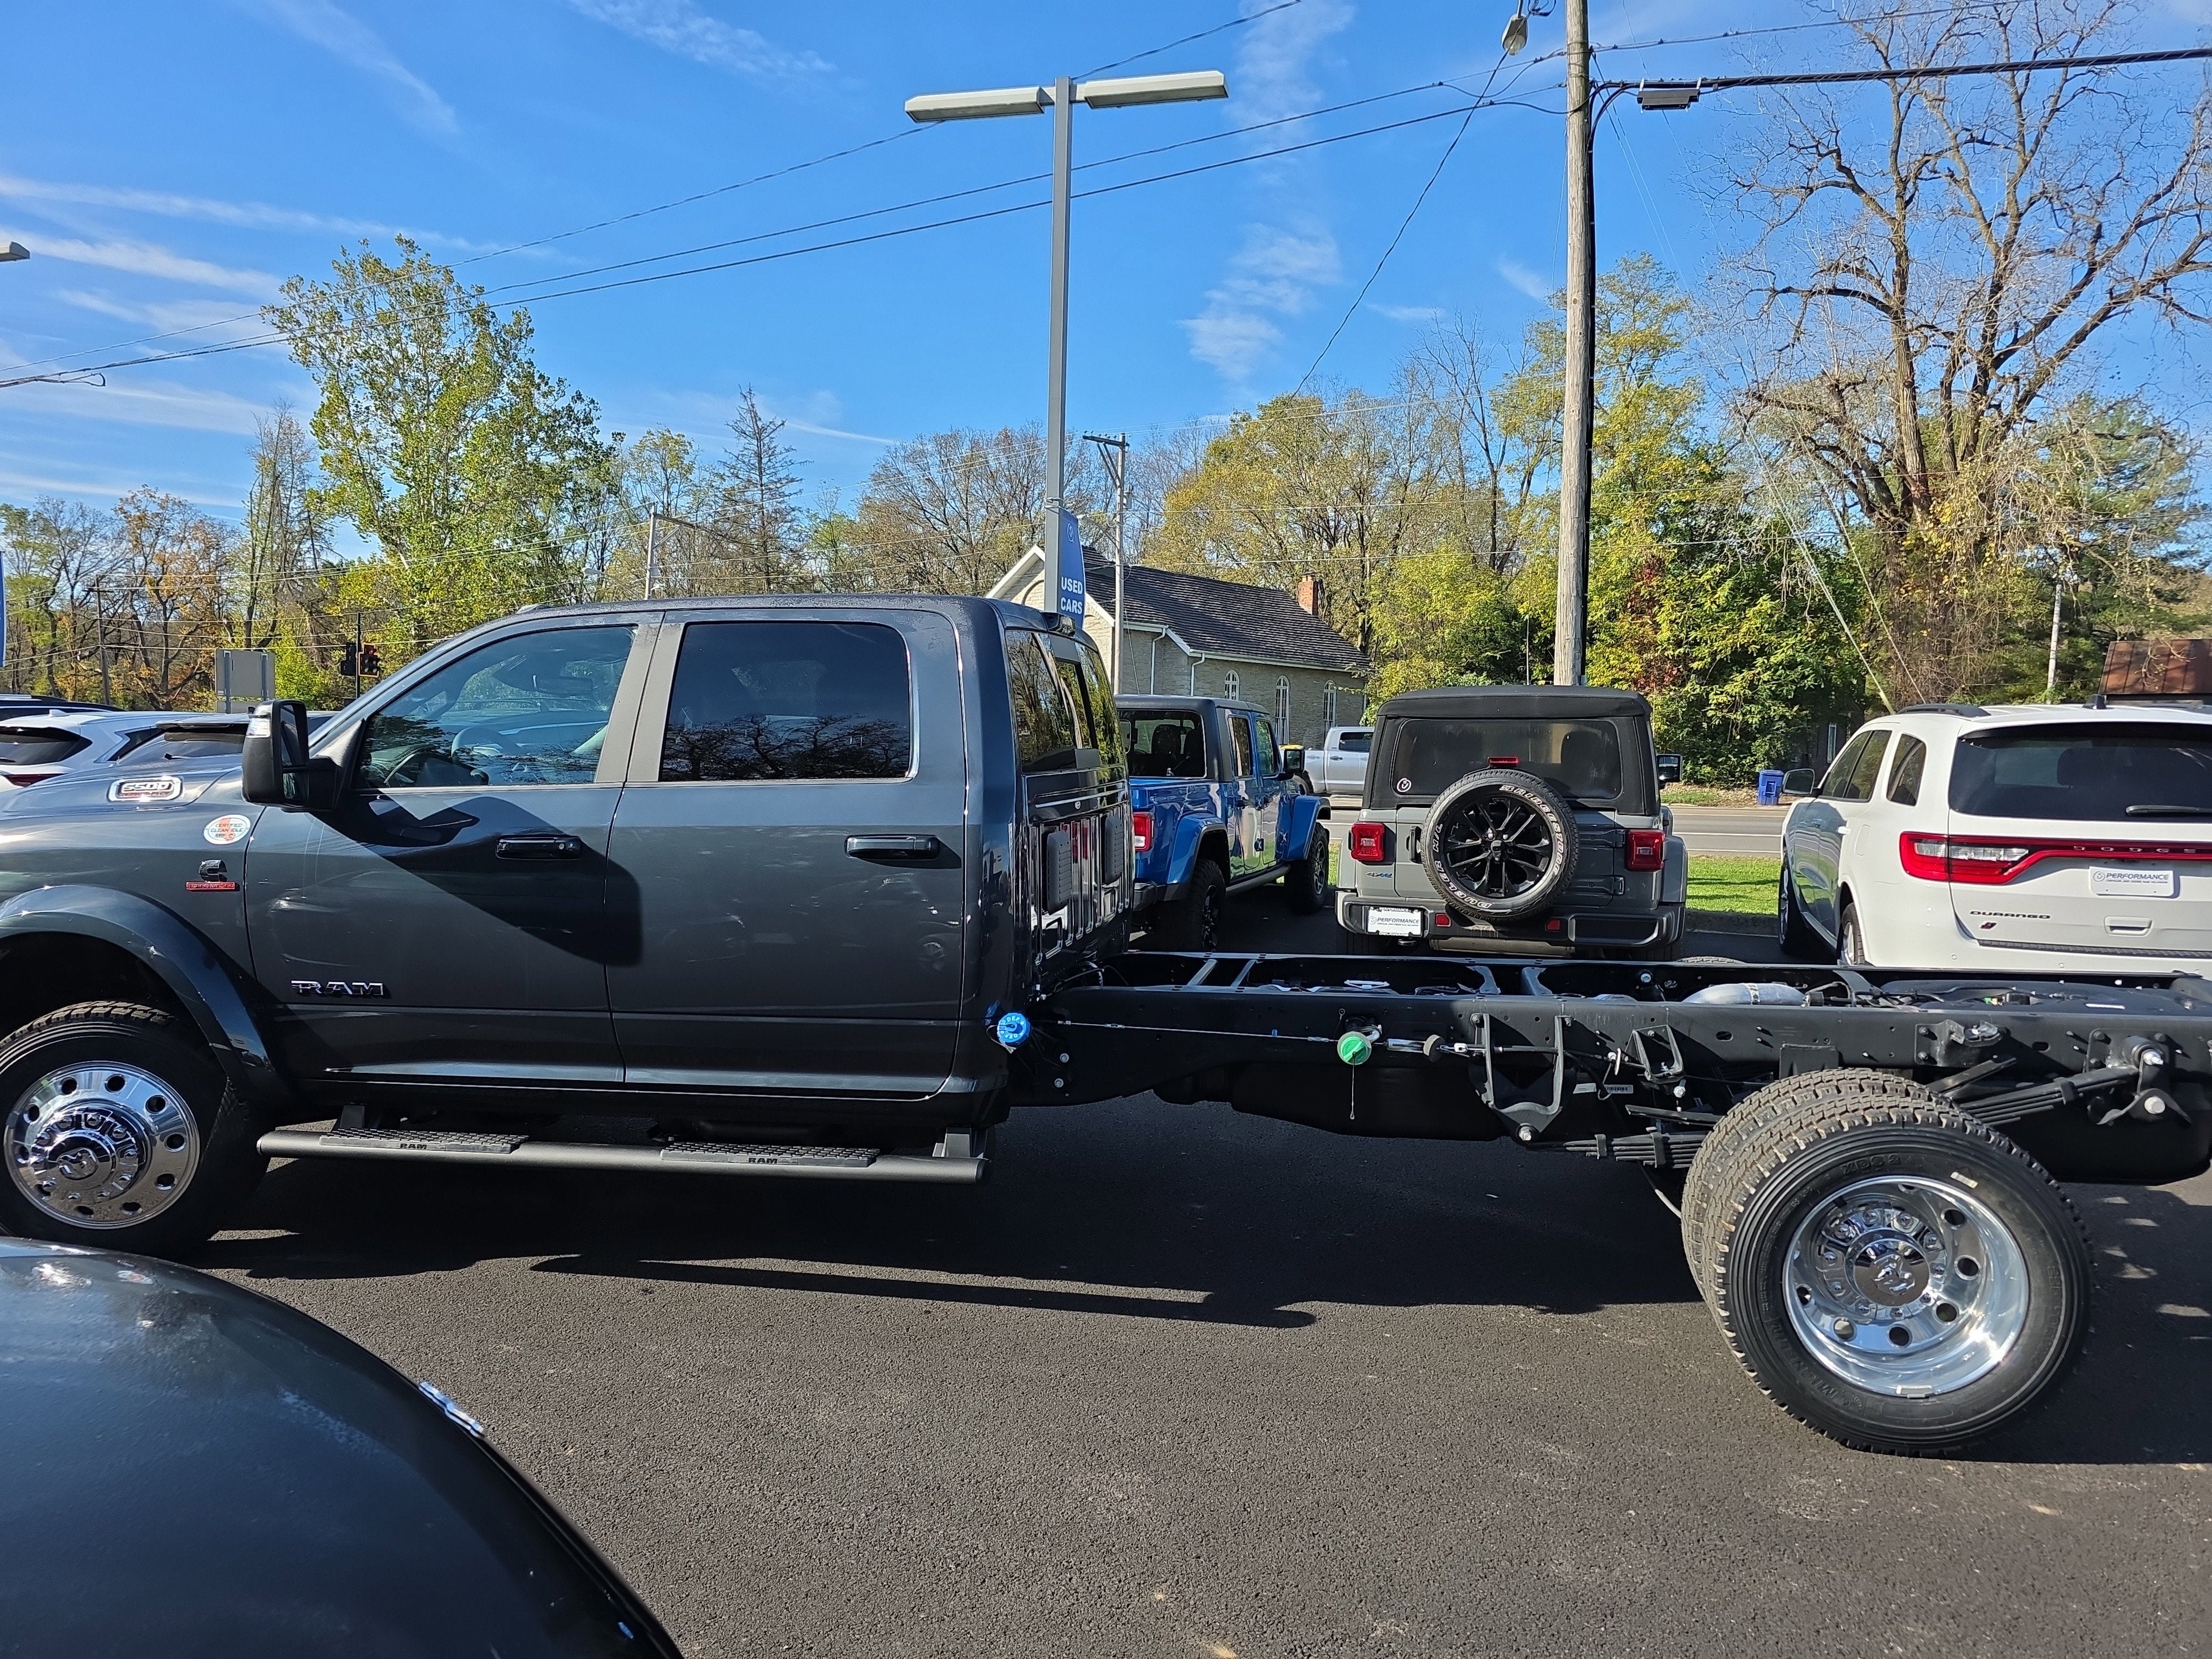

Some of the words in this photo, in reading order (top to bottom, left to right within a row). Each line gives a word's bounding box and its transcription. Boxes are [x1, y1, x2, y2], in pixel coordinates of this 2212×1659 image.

[1061, 576, 1083, 594] USED
[1061, 597, 1083, 614] CARS
[122, 782, 172, 792] 5500
[1499, 785, 1564, 875] BRIDGESTONE
[2073, 845, 2196, 853] DODGE
[1434, 860, 1493, 909] DUELER
[1970, 911, 2050, 919] DURANGO
[291, 980, 383, 996] RAM
